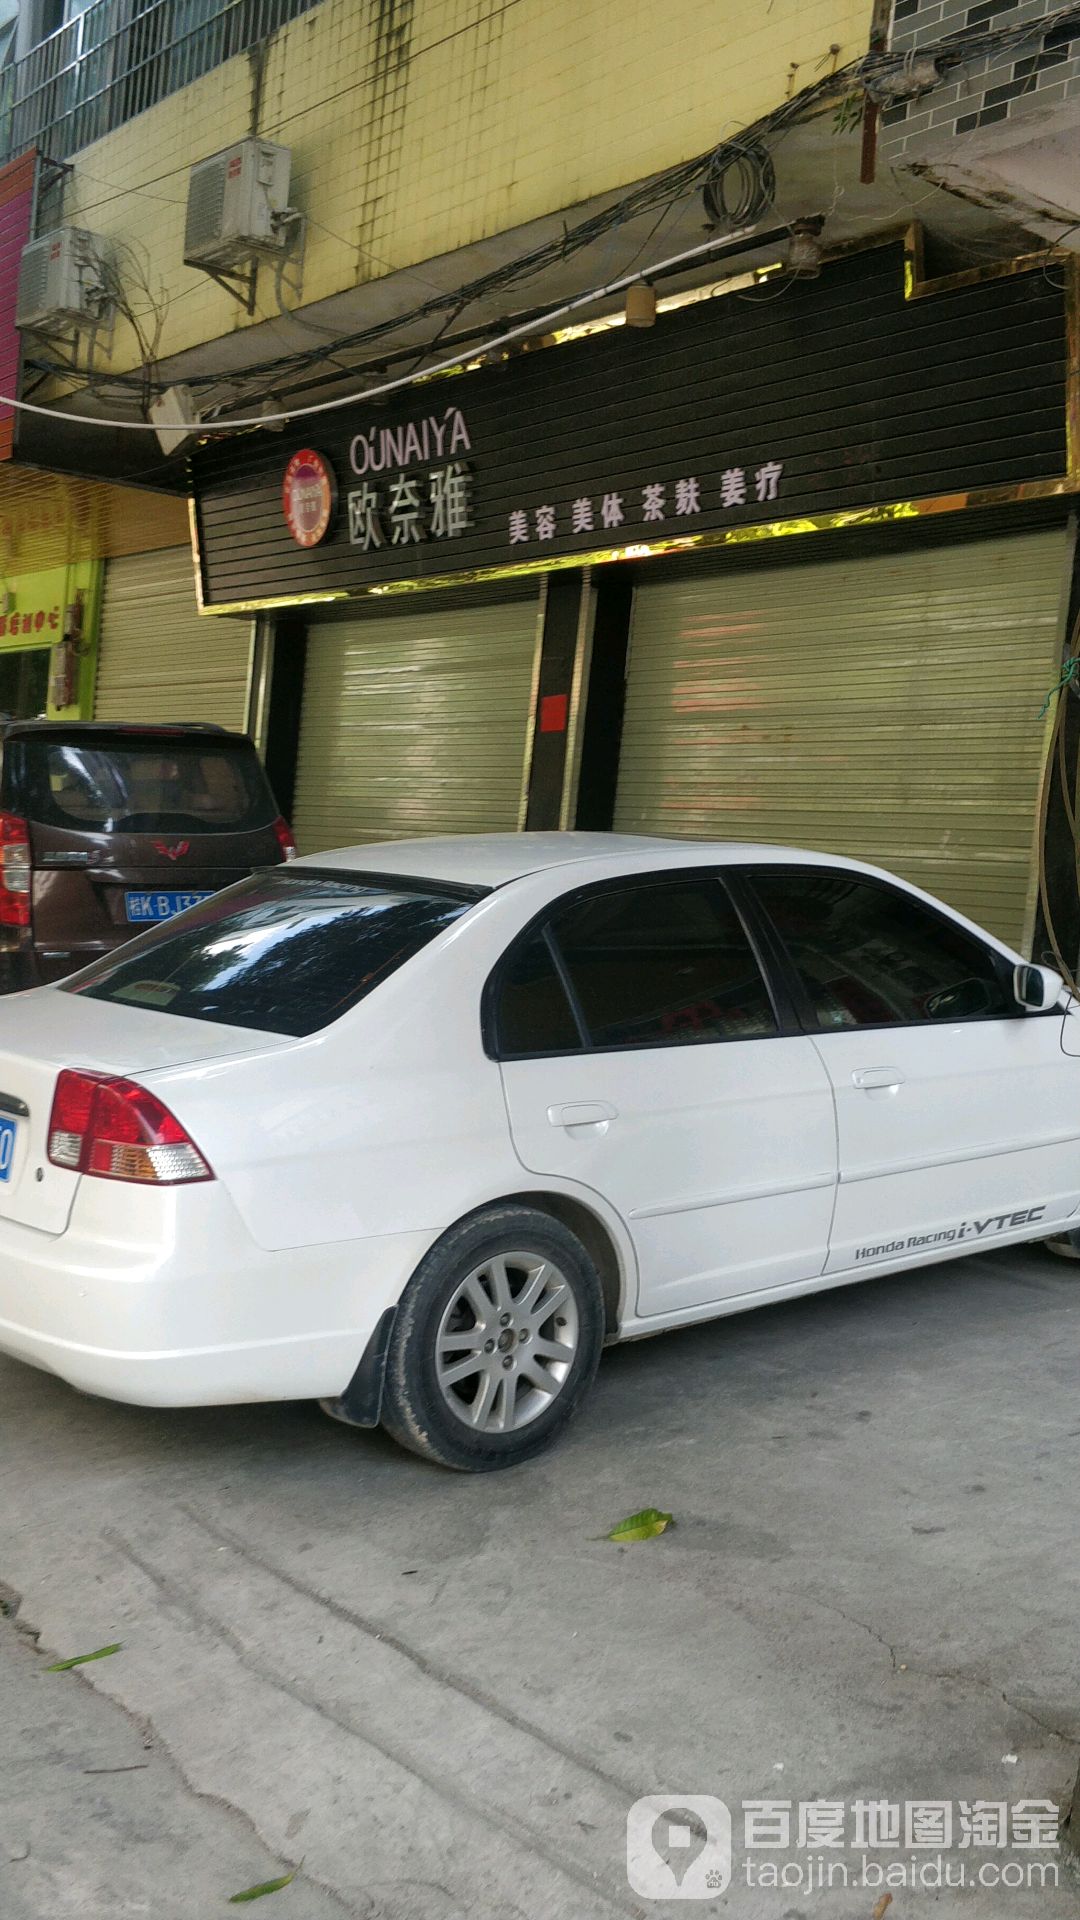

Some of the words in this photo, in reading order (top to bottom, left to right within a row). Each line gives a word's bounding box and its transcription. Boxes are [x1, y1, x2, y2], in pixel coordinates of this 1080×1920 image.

[348, 462, 475, 550] 欧奈雅
[509, 505, 557, 544] 美容
[572, 491, 624, 534] 美体
[720, 461, 783, 508] 姜疗
[855, 1241, 905, 1260] Honda
[907, 1228, 956, 1248] Racing
